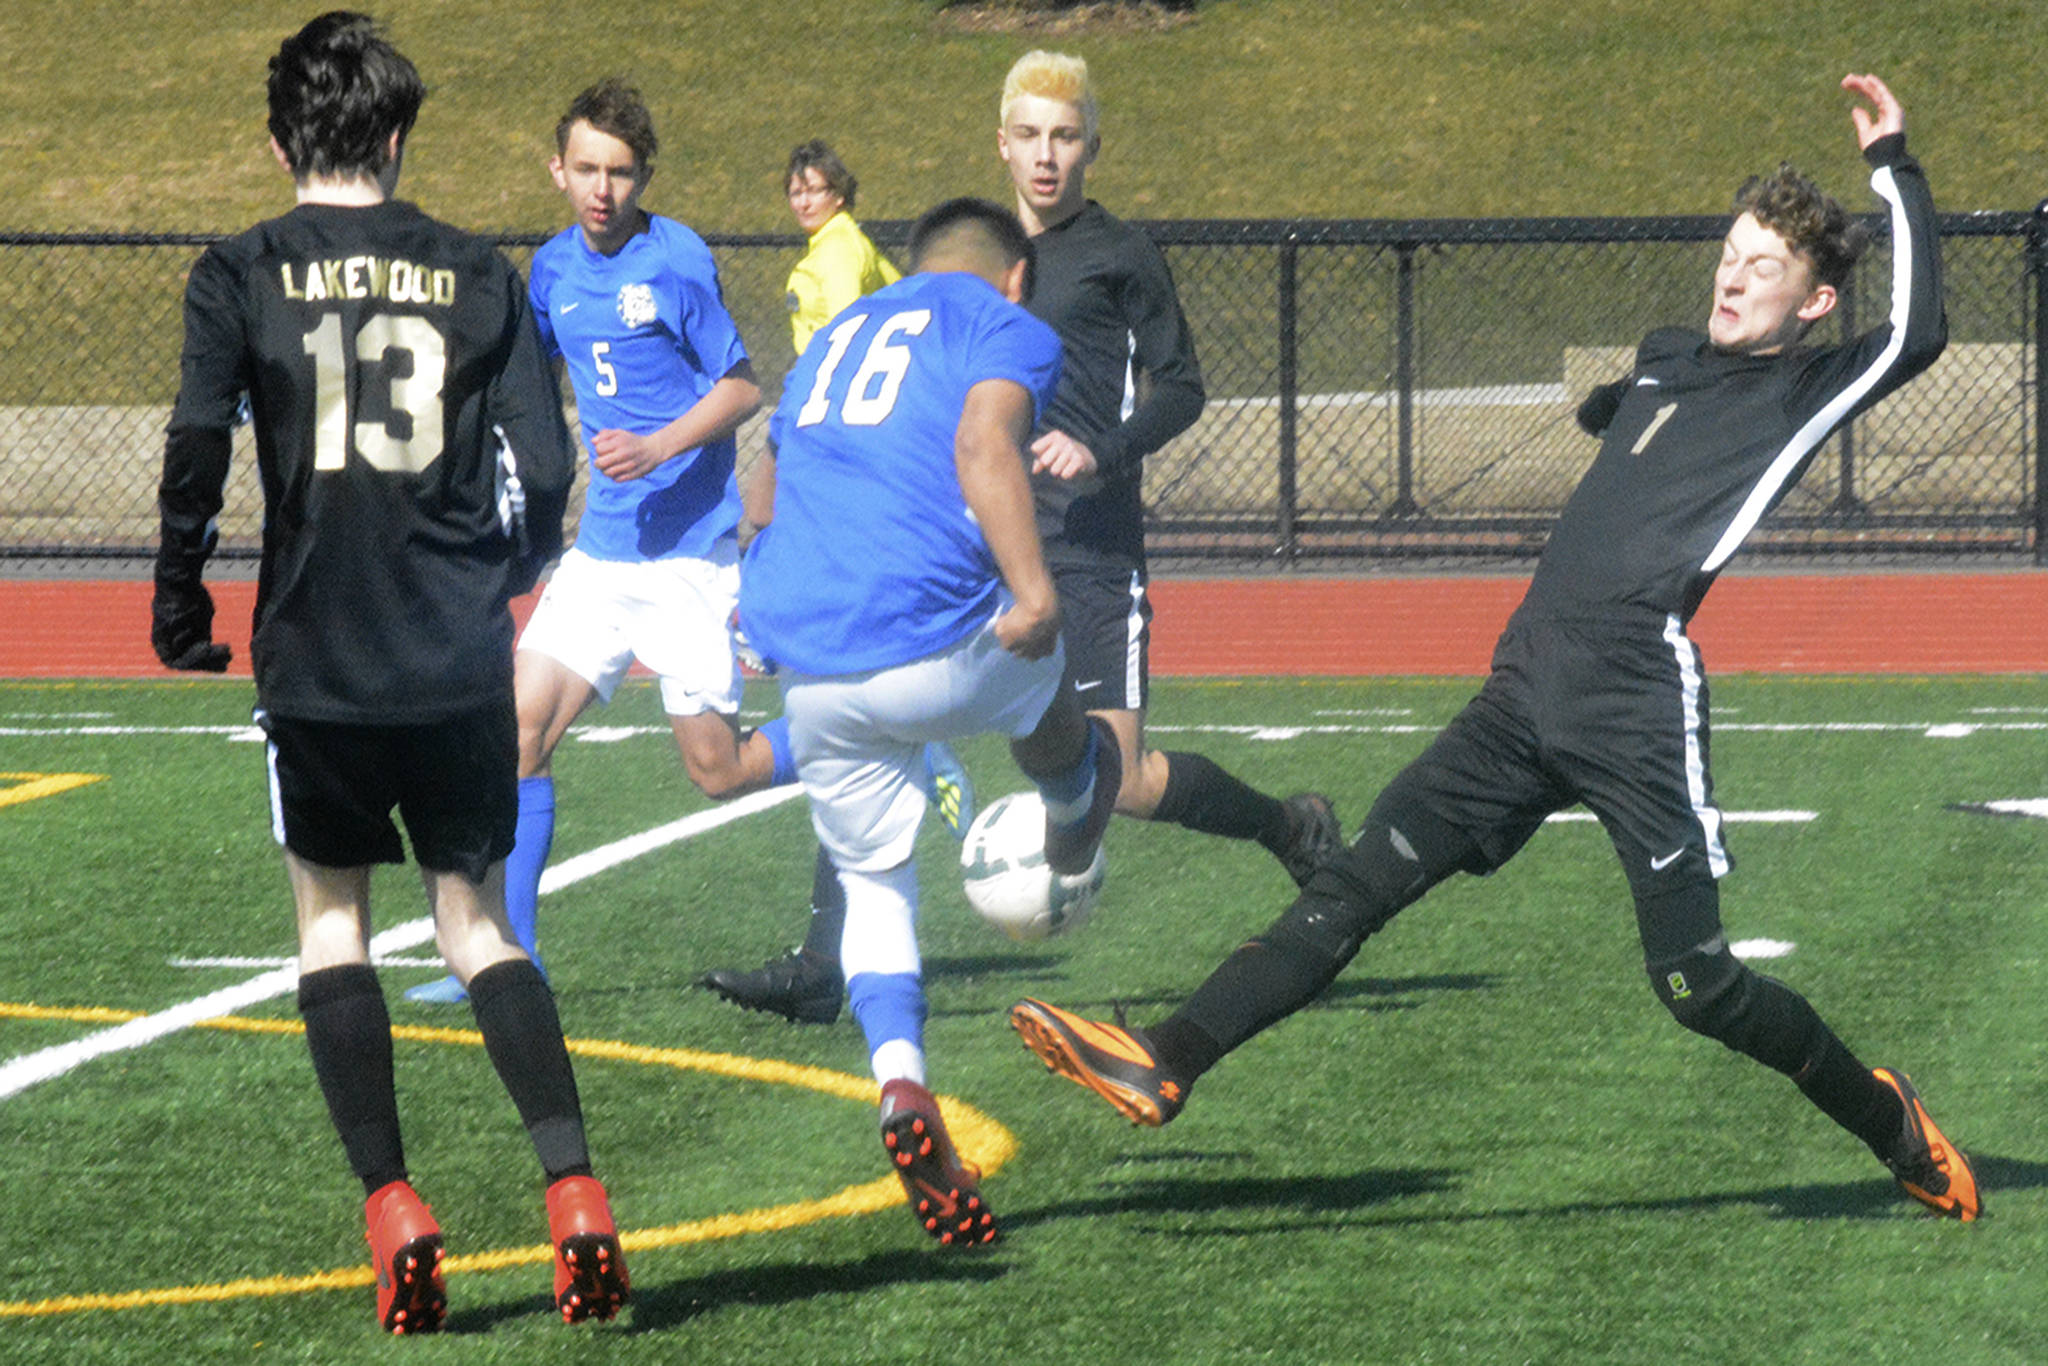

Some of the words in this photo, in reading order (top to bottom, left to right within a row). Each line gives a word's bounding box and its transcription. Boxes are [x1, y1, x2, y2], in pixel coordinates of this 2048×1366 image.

[281, 255, 456, 306] LAKEWOOD
[303, 312, 446, 473] 13
[592, 342, 617, 396] 5
[796, 309, 931, 427] 16
[1631, 402, 1678, 455] 1
